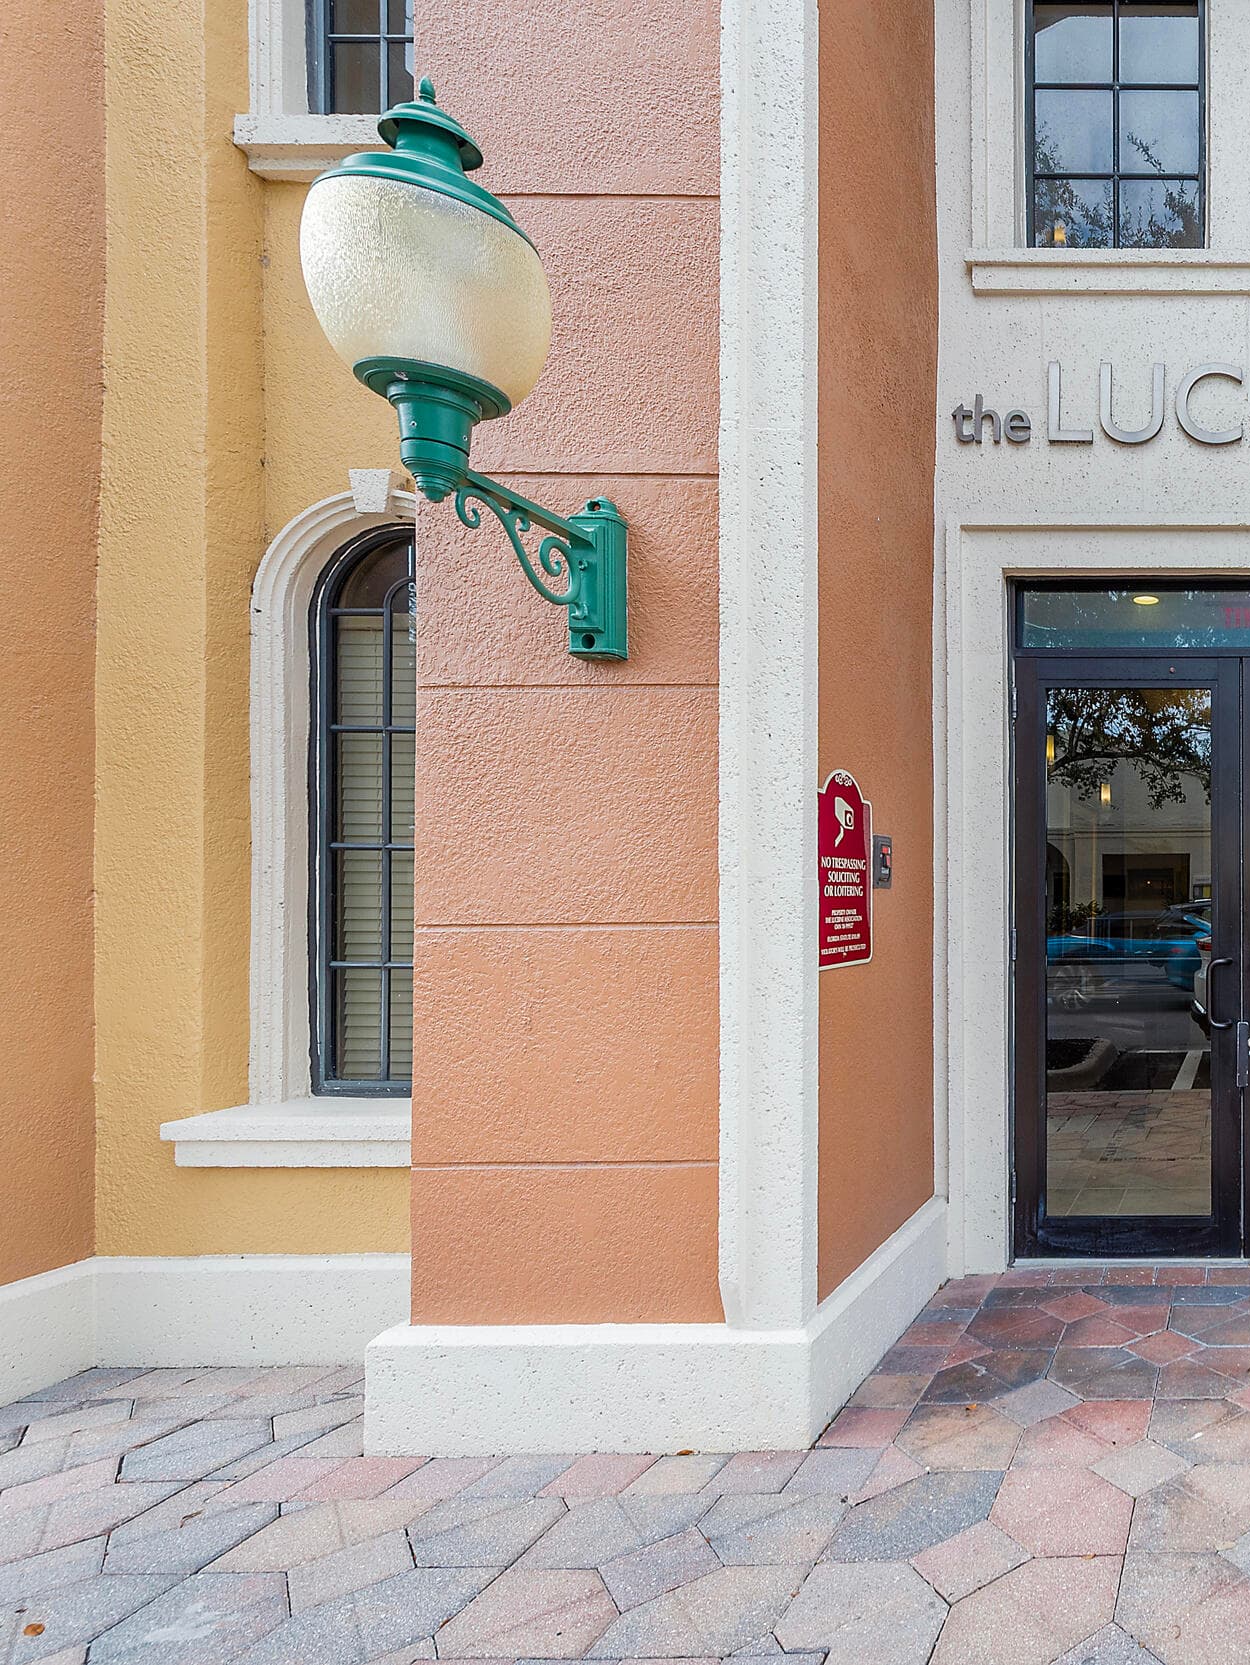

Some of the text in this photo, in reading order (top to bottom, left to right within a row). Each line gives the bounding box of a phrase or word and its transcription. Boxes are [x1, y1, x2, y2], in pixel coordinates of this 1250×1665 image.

[951, 393, 1032, 445] the
[821, 856, 866, 870] NO TRESPASSING
[828, 871, 860, 883] SOLICITING
[824, 885, 864, 897] OR LOITERING
